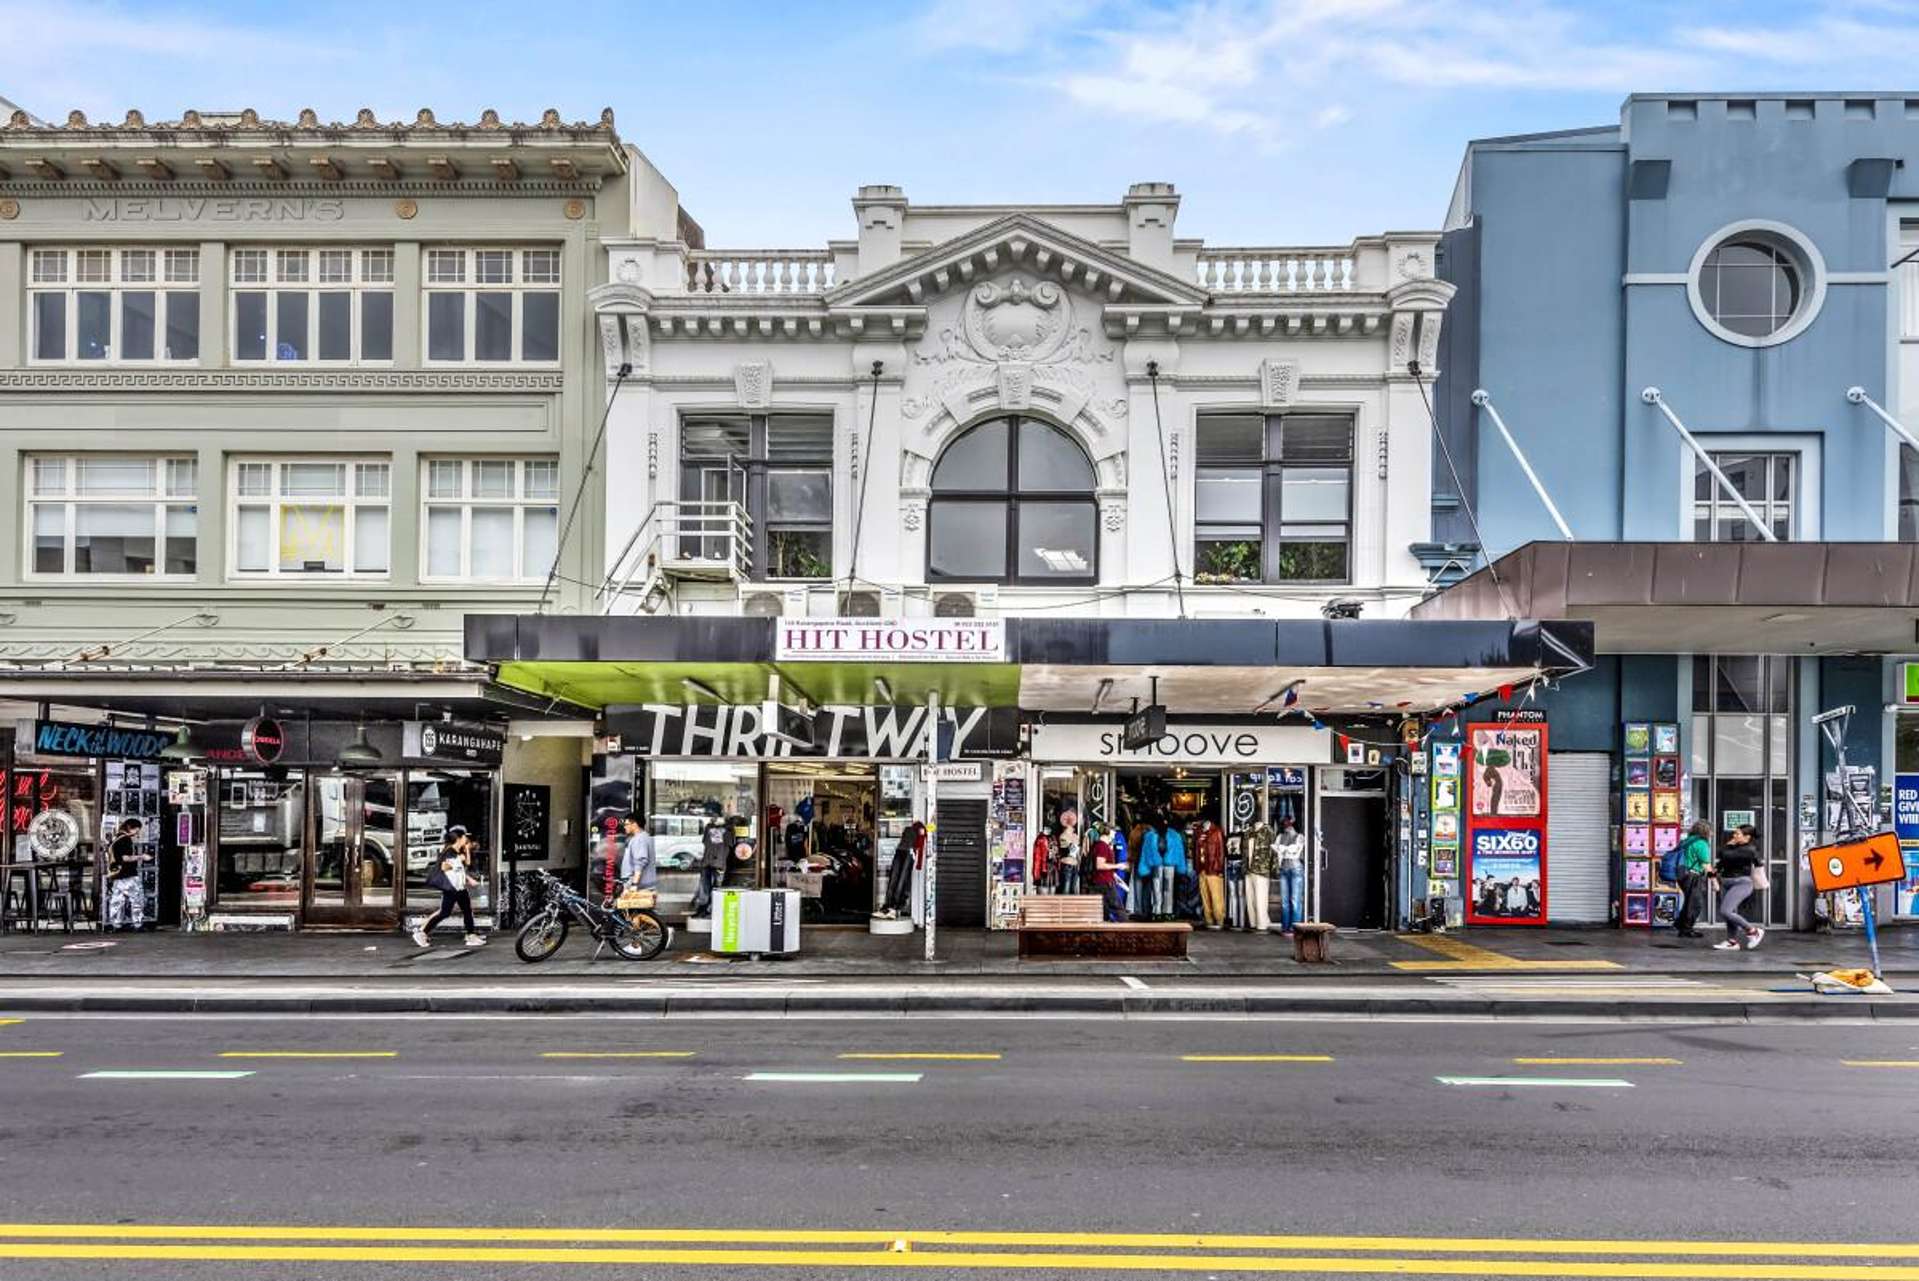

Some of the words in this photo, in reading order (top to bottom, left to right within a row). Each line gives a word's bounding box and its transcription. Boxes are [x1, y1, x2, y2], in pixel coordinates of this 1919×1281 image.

[81, 198, 346, 222] MELVERN'S
[783, 629, 848, 650] HIT
[858, 629, 999, 651] HOSTEL
[37, 724, 94, 752] NECK
[107, 731, 168, 757] WOODS
[1496, 731, 1537, 748] Naked
[1898, 789, 1918, 800] RED
[1476, 835, 1538, 851] SIX60
